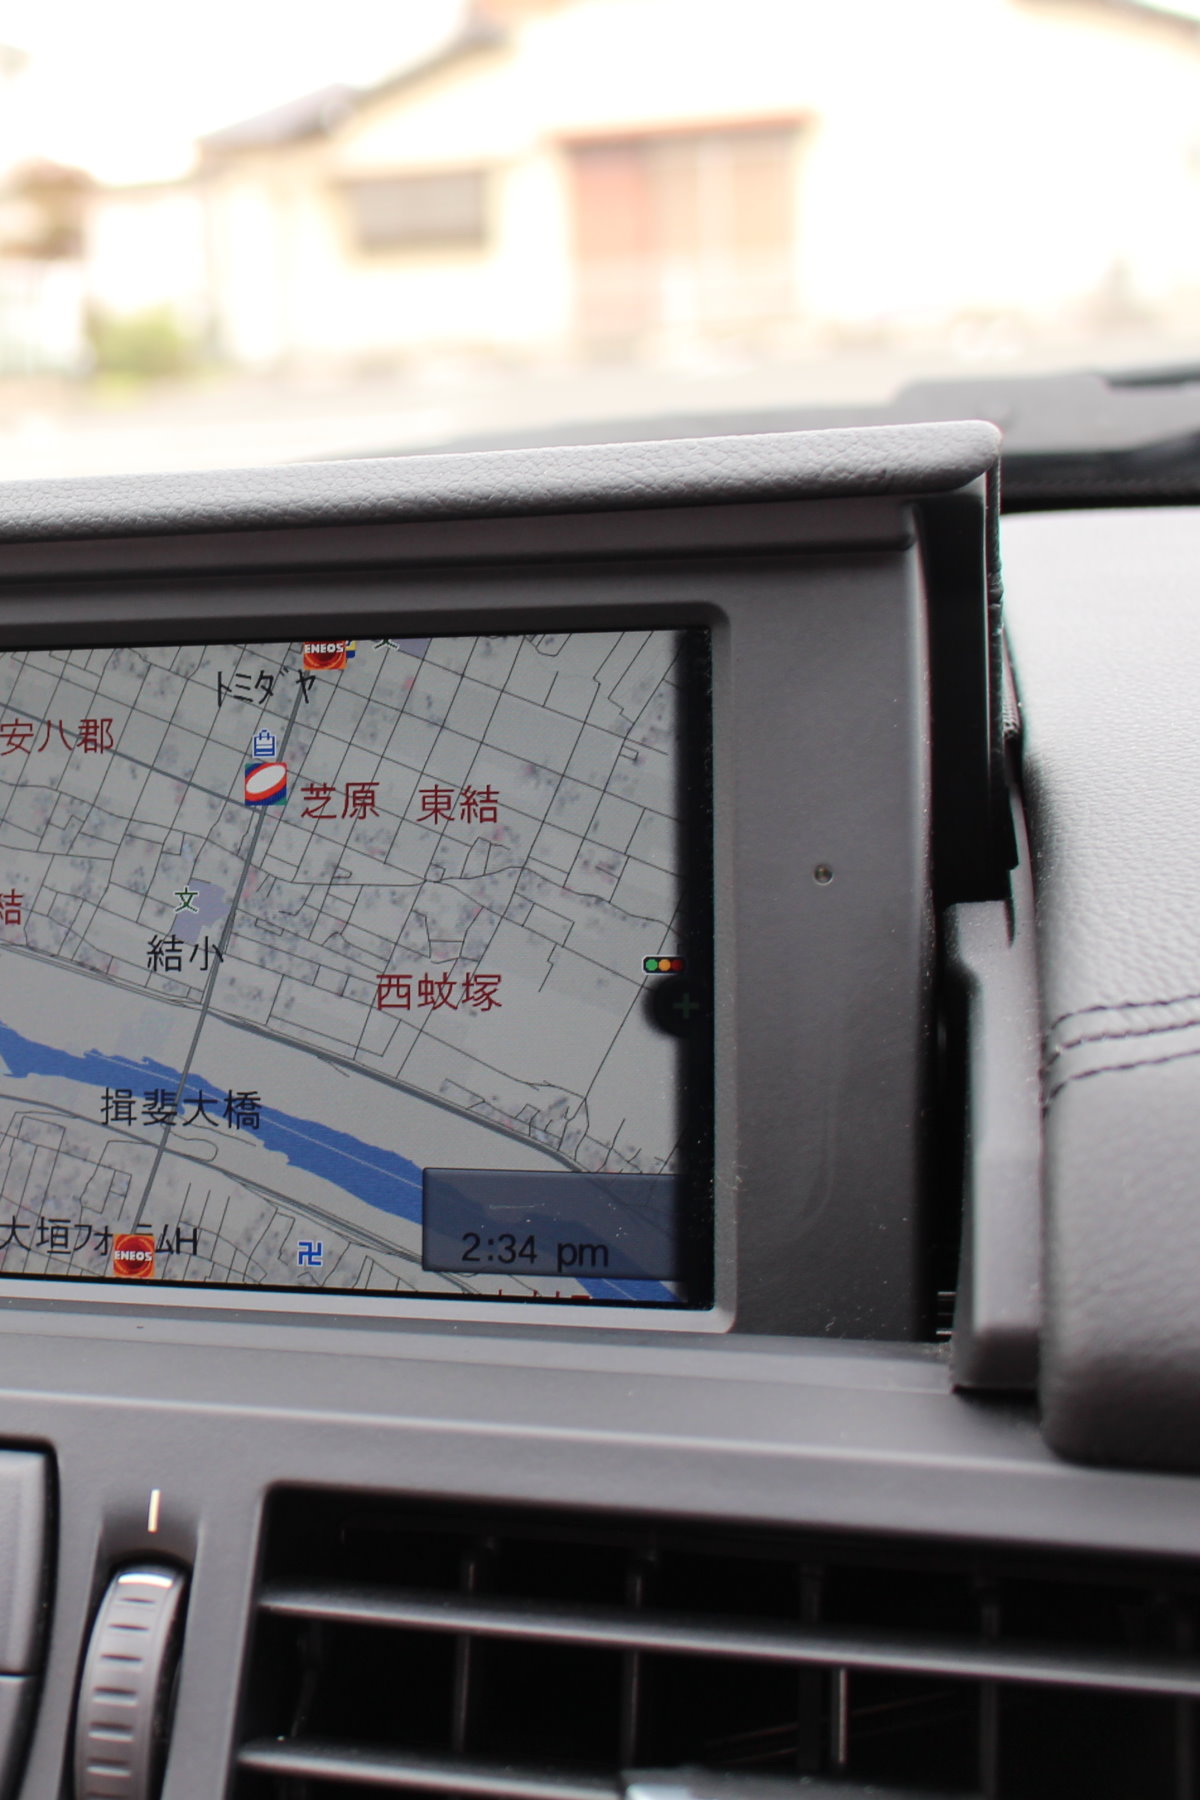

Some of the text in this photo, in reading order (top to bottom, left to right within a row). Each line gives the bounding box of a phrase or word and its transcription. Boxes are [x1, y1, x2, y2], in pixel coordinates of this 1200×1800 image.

[304, 643, 344, 654] ENEOS
[0, 717, 114, 756] 安八郡
[300, 781, 381, 820] 芝原
[416, 783, 500, 825] 東結
[146, 933, 225, 973] 結小
[375, 972, 503, 1013] 西蚊塚
[100, 1086, 262, 1131] 揖斐大橋
[114, 1251, 153, 1261] ENEOS
[461, 1231, 609, 1273] 2:34 pm
